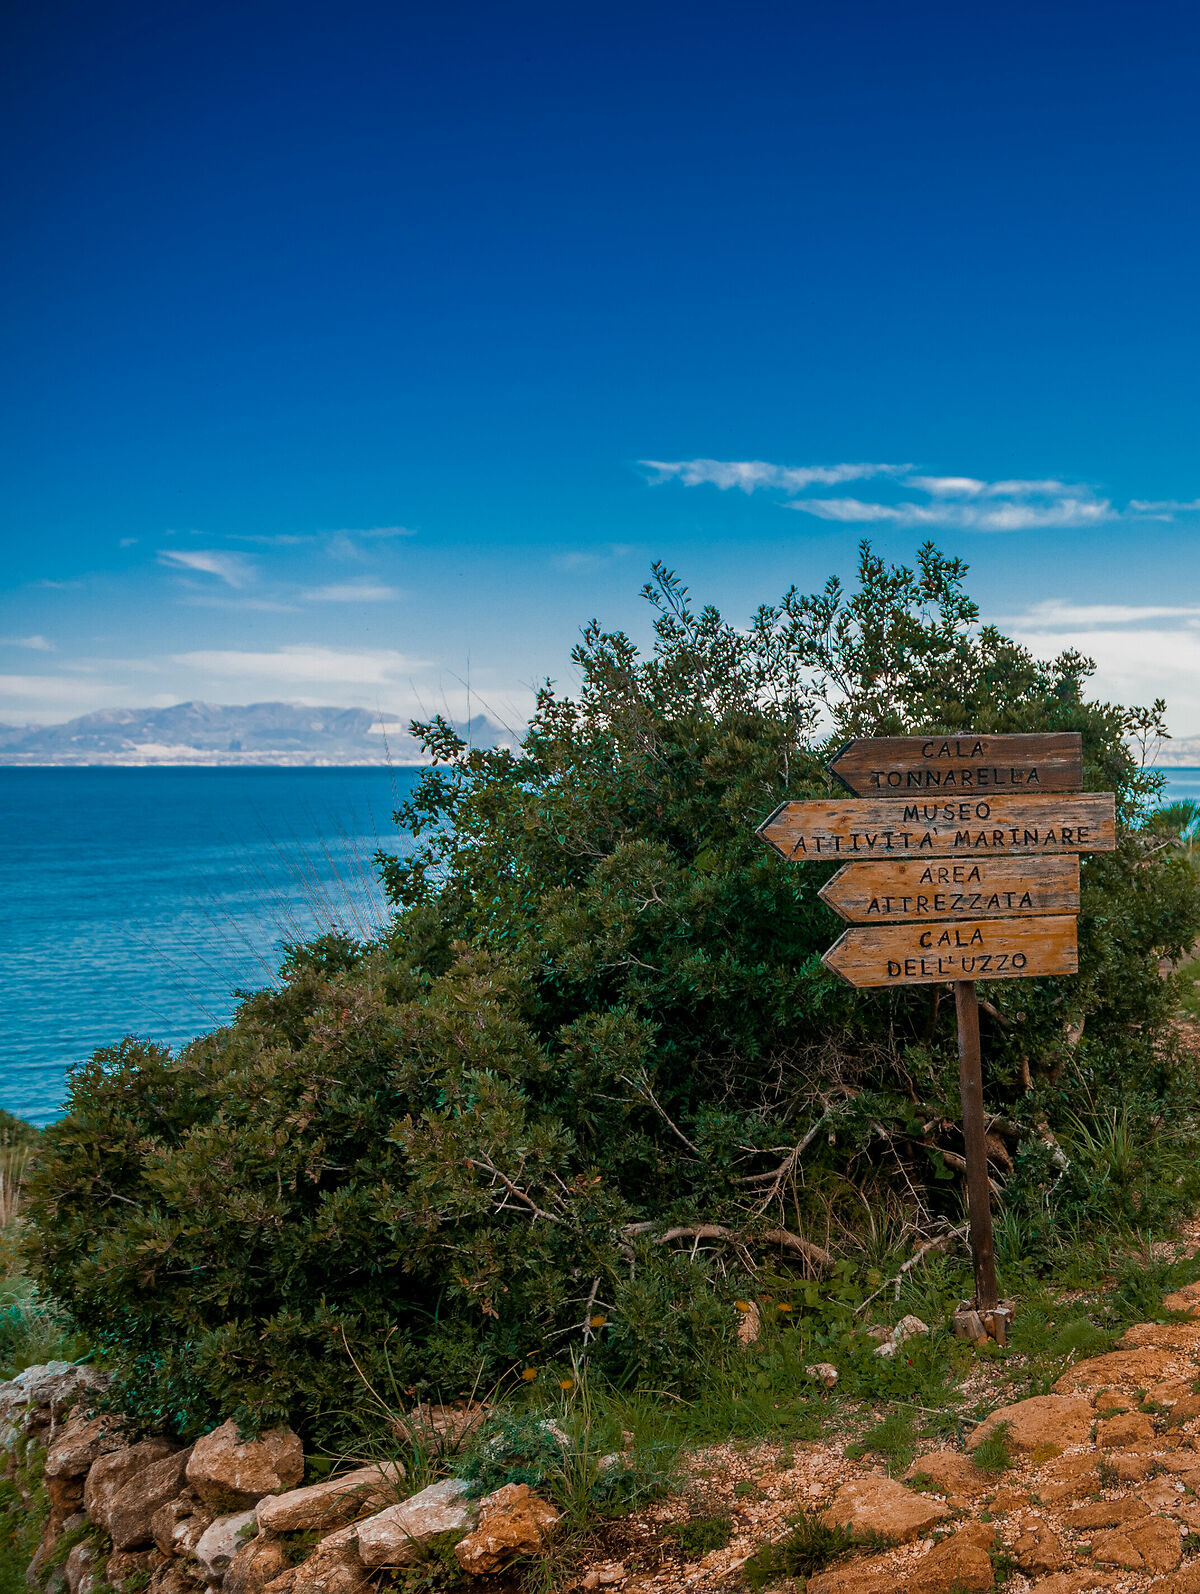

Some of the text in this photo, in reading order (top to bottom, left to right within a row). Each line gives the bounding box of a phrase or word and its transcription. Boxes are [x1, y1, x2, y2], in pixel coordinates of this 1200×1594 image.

[921, 740, 985, 759] CALA
[870, 767, 1041, 789] TONNARELLA
[903, 802, 992, 822] MUSEO
[793, 826, 1090, 852] ATTIVITA' MARINARE
[919, 866, 982, 884] AREA
[867, 890, 1033, 915] ATTREZZATA
[919, 928, 984, 948] CALA
